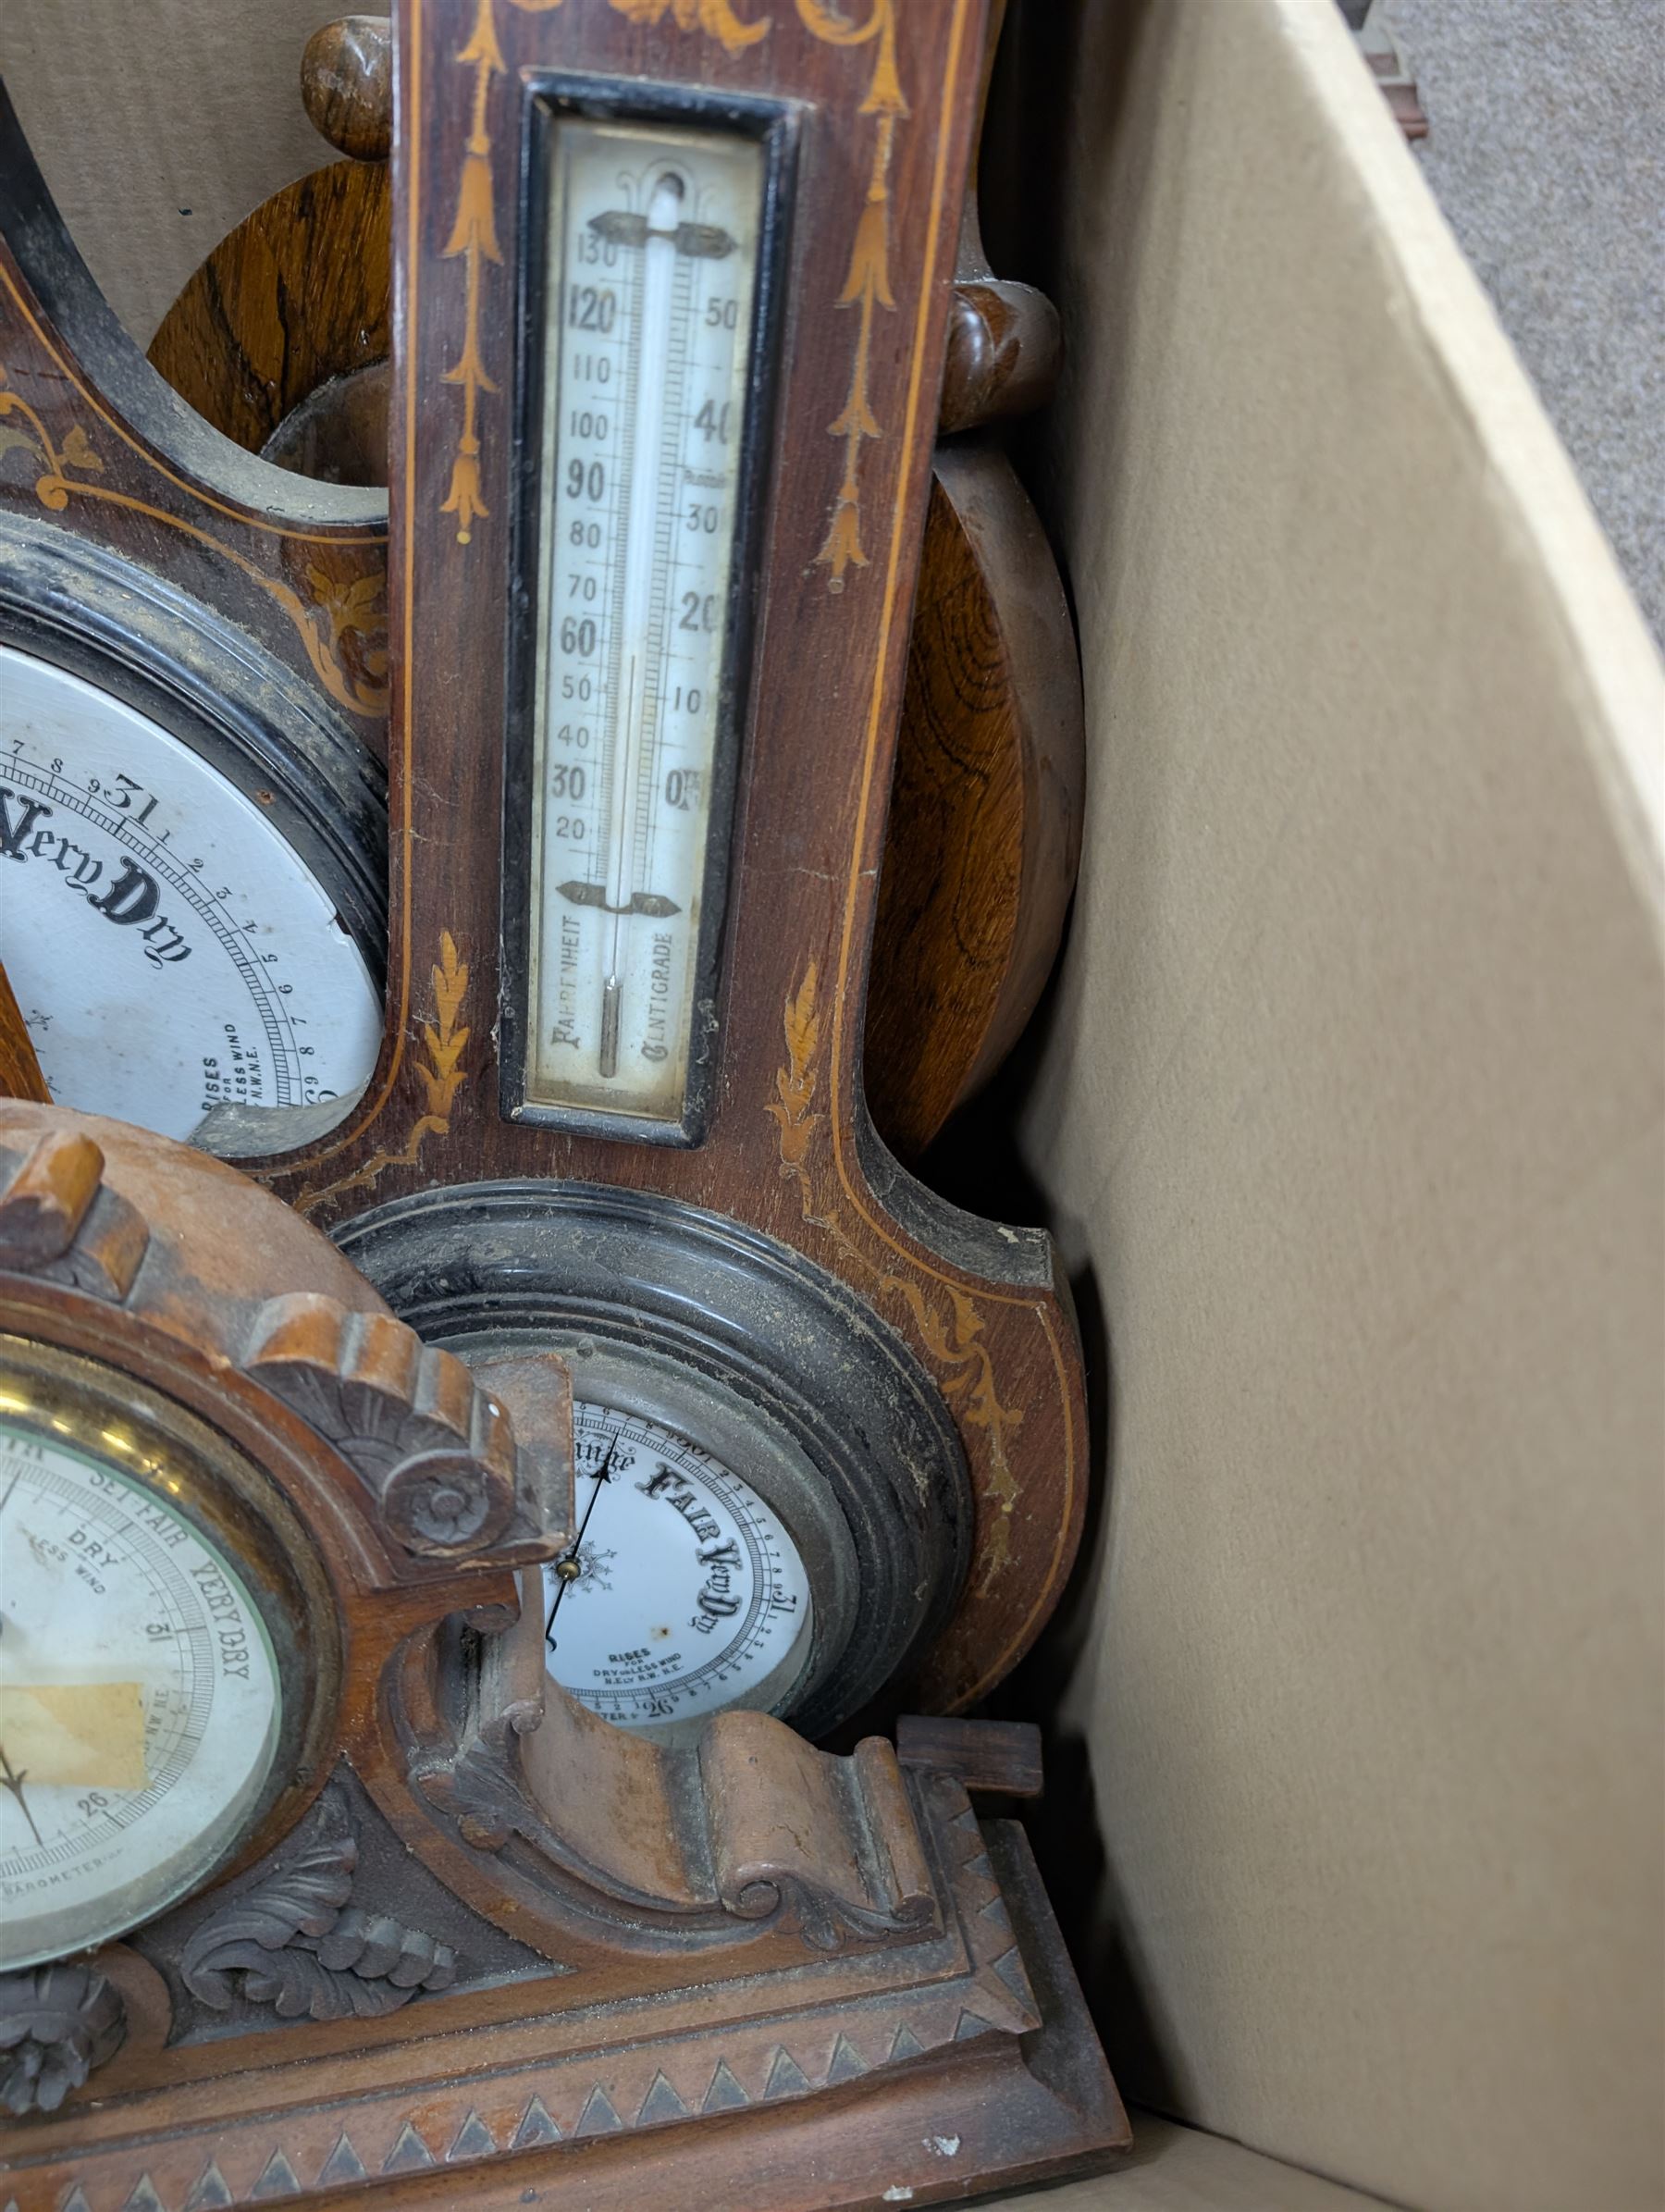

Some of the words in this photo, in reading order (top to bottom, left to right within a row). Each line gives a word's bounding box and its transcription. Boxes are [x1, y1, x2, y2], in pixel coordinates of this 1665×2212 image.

[568, 284, 617, 334] 120
[705, 298, 737, 330] 50
[574, 355, 610, 384] 110
[571, 410, 609, 440] 100
[566, 459, 605, 502] 90
[686, 502, 719, 535] 30
[570, 520, 600, 549] 80
[567, 574, 597, 601] 70
[560, 616, 598, 659] 60
[561, 674, 592, 702] 50
[674, 686, 701, 715] 10
[13, 740, 25, 755] 7
[557, 724, 589, 749] 40
[51, 758, 64, 773] 8
[88, 779, 101, 794] 9
[552, 763, 586, 801] 30
[104, 773, 159, 831] 31
[156, 829, 171, 846] 1
[556, 815, 586, 841] 20
[0, 785, 104, 897] Very
[86, 855, 192, 970] Dry
[187, 858, 204, 873] 2
[216, 886, 233, 900] 3
[241, 919, 259, 933] 4
[261, 953, 278, 963] 5
[278, 983, 293, 995] 6
[290, 1016, 308, 1026] 7
[224, 1023, 242, 1061] WIND
[299, 1046, 315, 1057] 8
[634, 1461, 722, 1544] FAIR
[68, 1528, 119, 1567] DRY
[74, 1564, 106, 1594] WIND
[695, 1537, 744, 1593] Very
[687, 1588, 743, 1635] Dry
[771, 1590, 797, 1613] 31
[190, 1561, 240, 1624] VERY
[218, 1628, 250, 1680] DRY
[609, 1647, 651, 1663] RISES
[630, 1662, 658, 1674] LESS
[658, 1652, 682, 1665] WIND
[77, 1791, 109, 1818] 26
